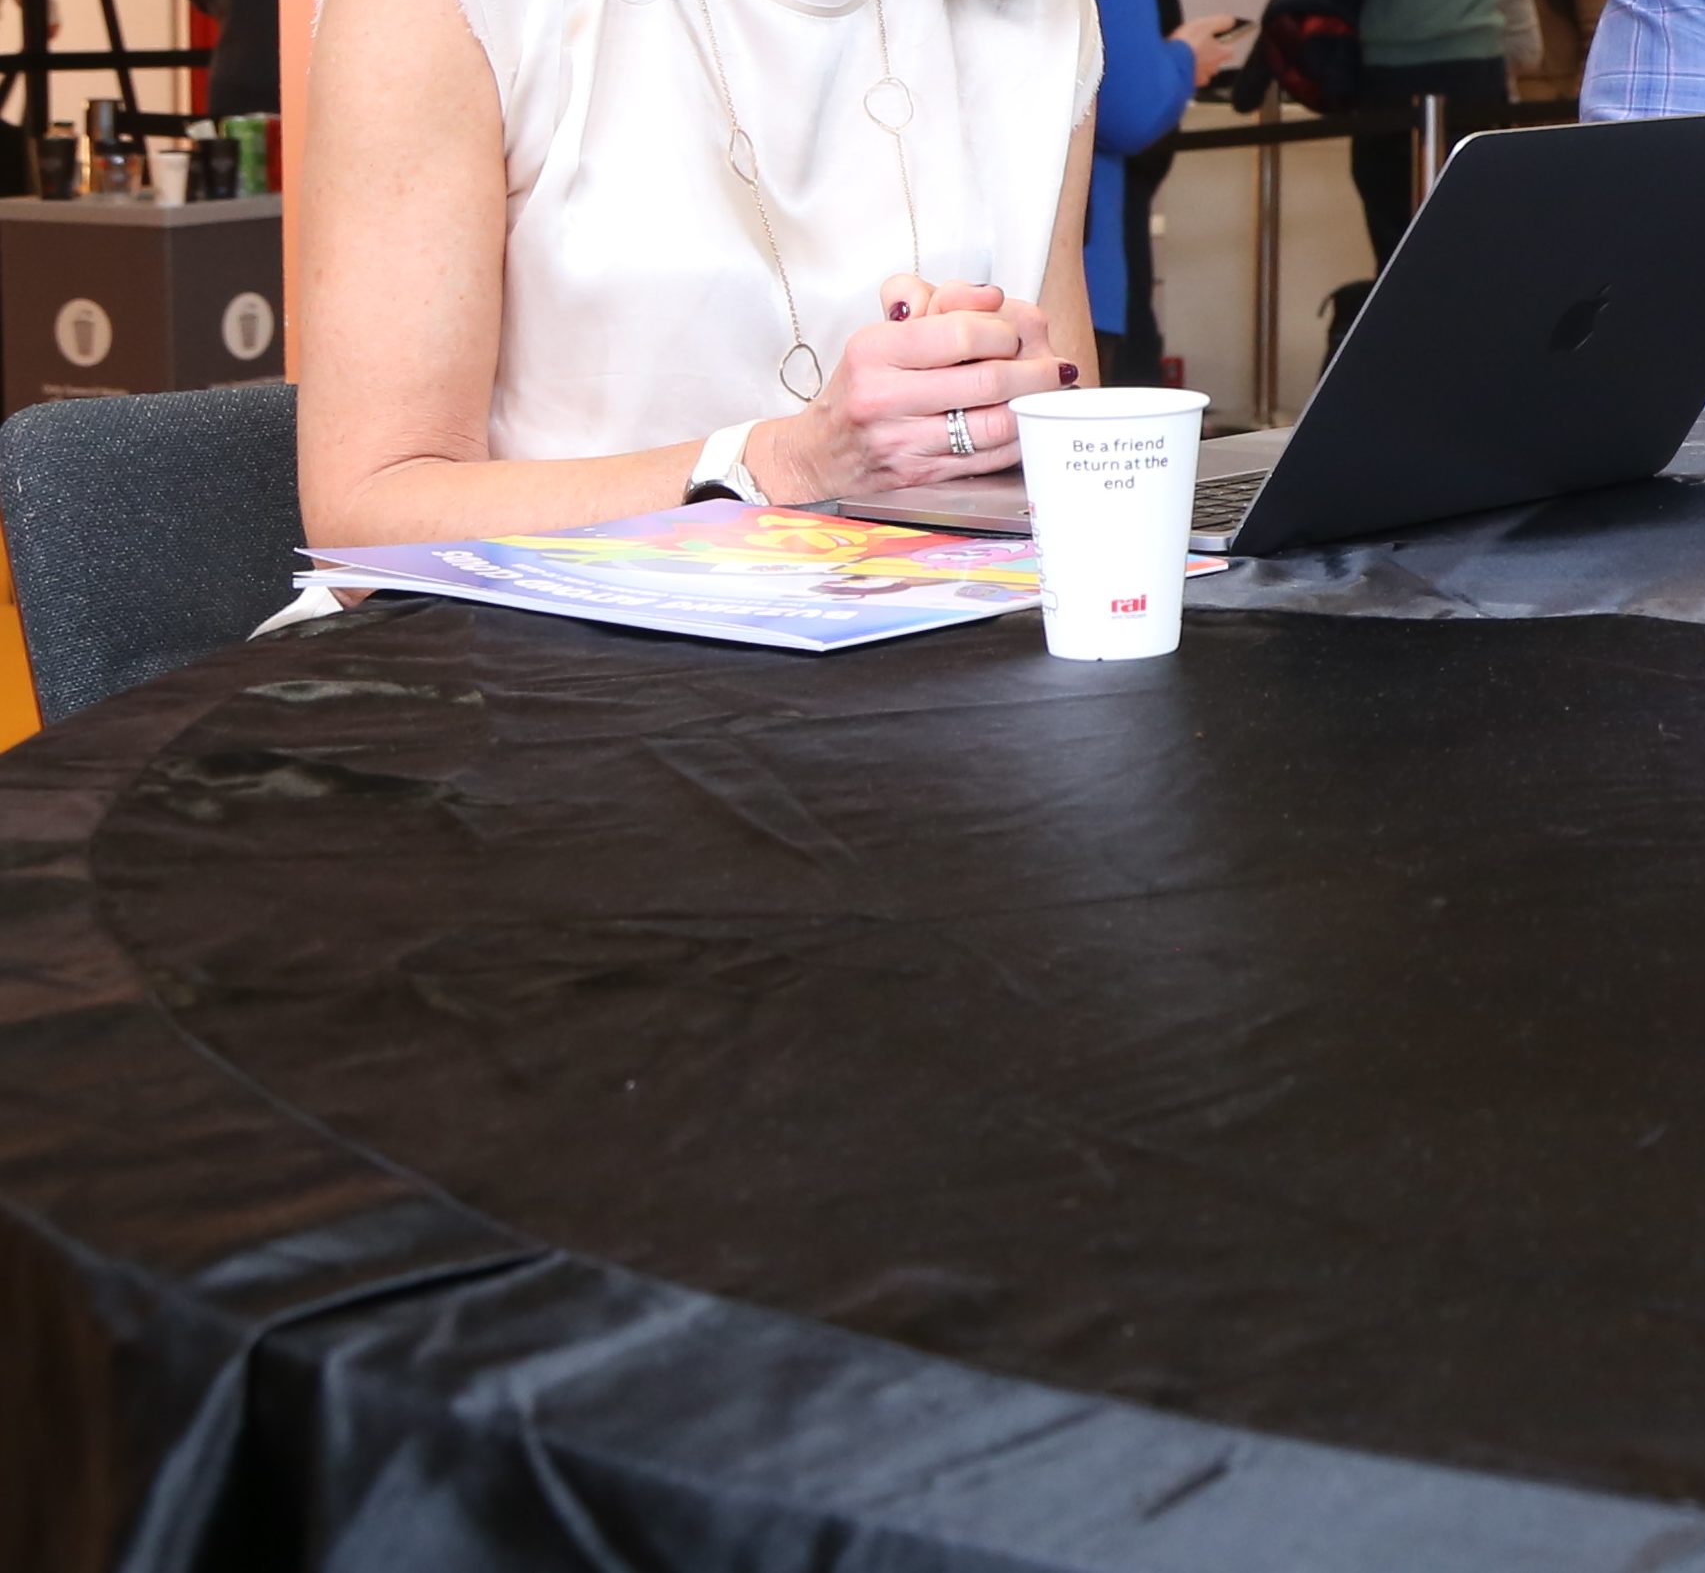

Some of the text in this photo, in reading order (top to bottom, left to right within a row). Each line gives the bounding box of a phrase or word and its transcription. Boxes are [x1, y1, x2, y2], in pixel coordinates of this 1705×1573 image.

[1072, 436, 1165, 453] Be a friend
[1066, 455, 1169, 472] return at the
[1103, 475, 1136, 490] end
[1110, 593, 1148, 614] rai
